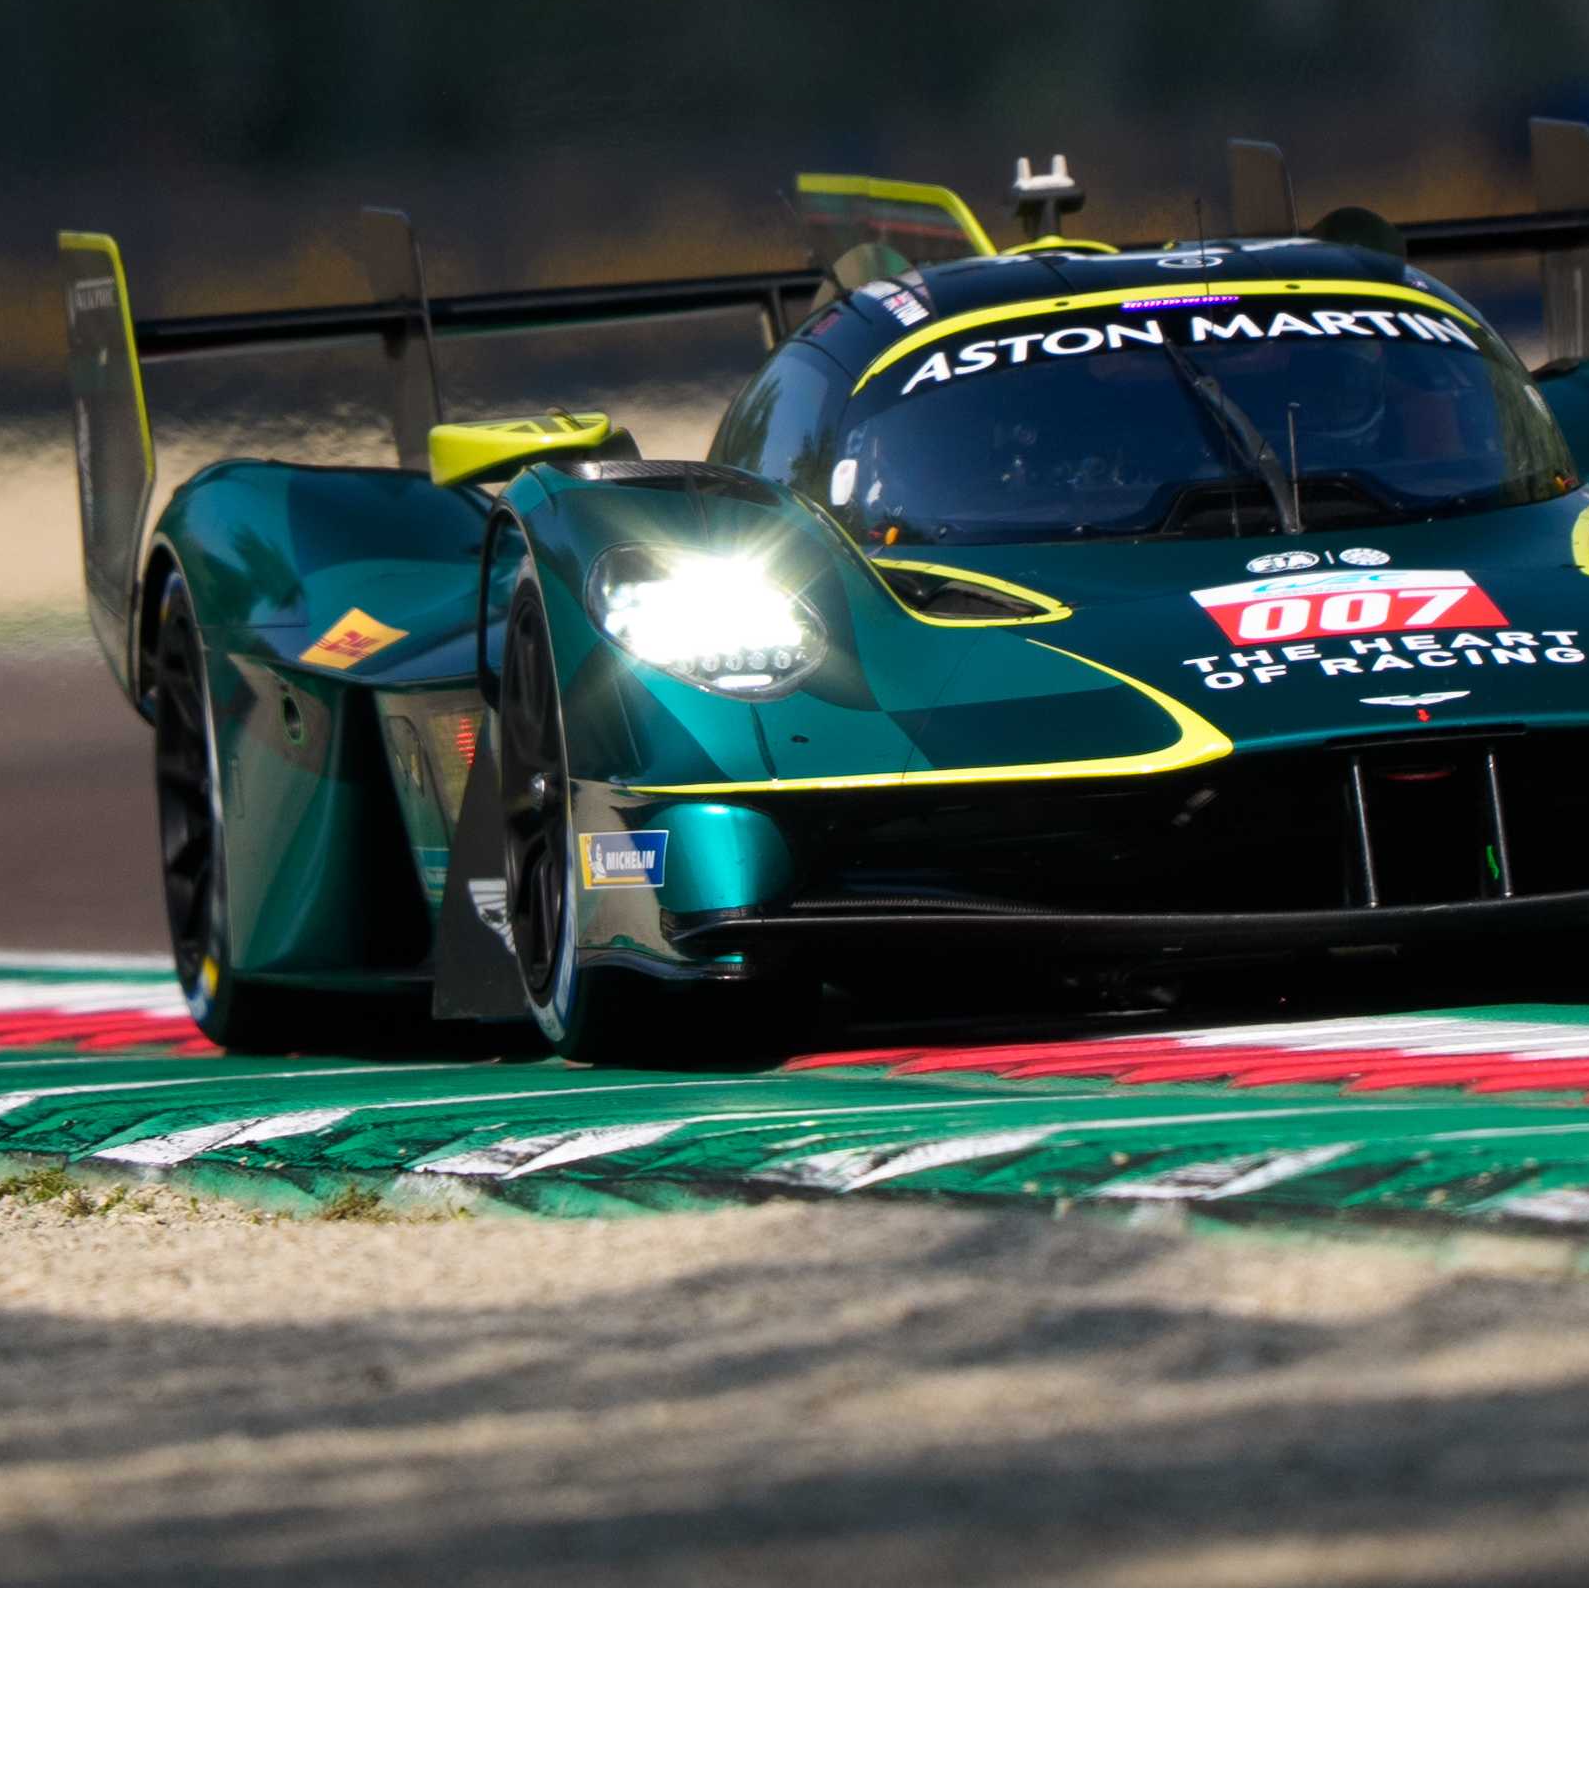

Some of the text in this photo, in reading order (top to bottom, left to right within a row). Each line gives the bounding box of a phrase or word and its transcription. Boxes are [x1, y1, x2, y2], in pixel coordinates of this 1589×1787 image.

[901, 310, 1480, 395] ASTON MARTIN
[1238, 588, 1469, 640] 007
[1183, 631, 1579, 673] THE HEART
[1204, 647, 1586, 689] OF RACING
[605, 851, 656, 870] MICHELIN
